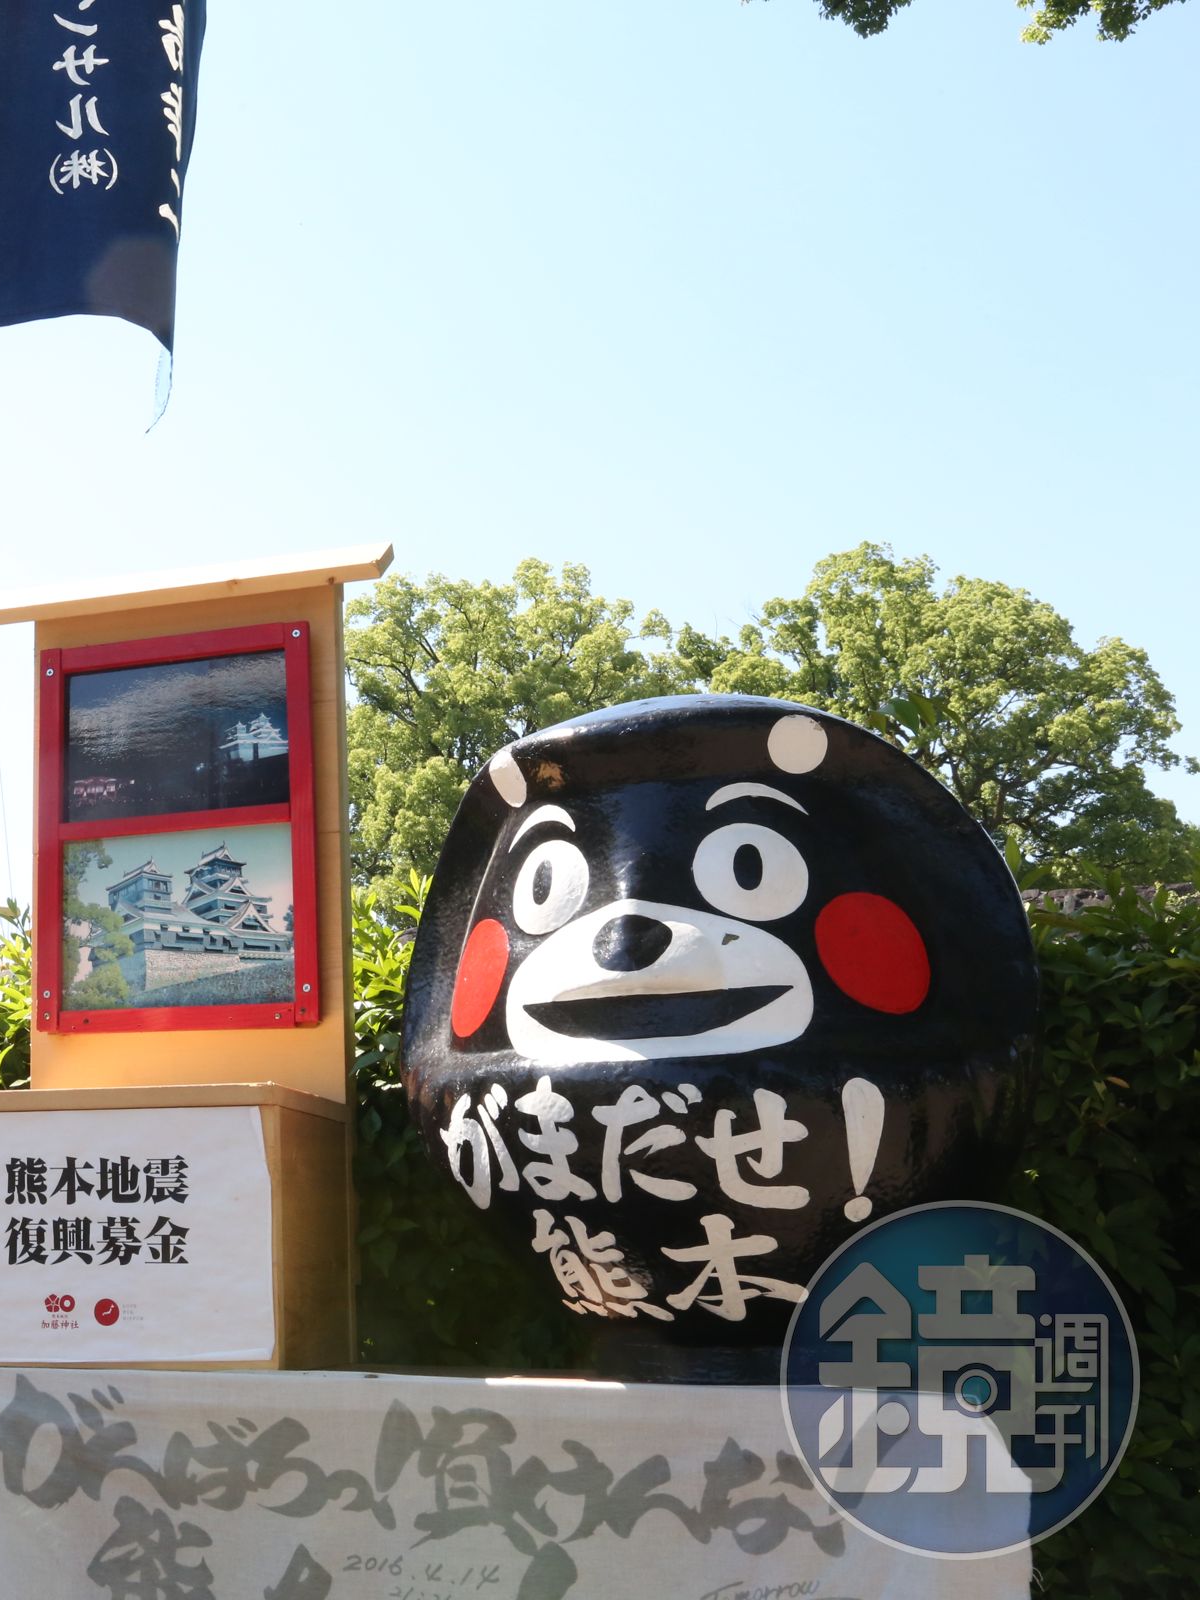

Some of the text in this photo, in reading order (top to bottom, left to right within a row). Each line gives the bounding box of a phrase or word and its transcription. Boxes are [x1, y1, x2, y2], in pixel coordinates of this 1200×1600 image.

[5, 1154, 190, 1206] 熊本地震
[4, 1215, 191, 1265] 復興募金
[531, 1208, 809, 1322] 熊本
